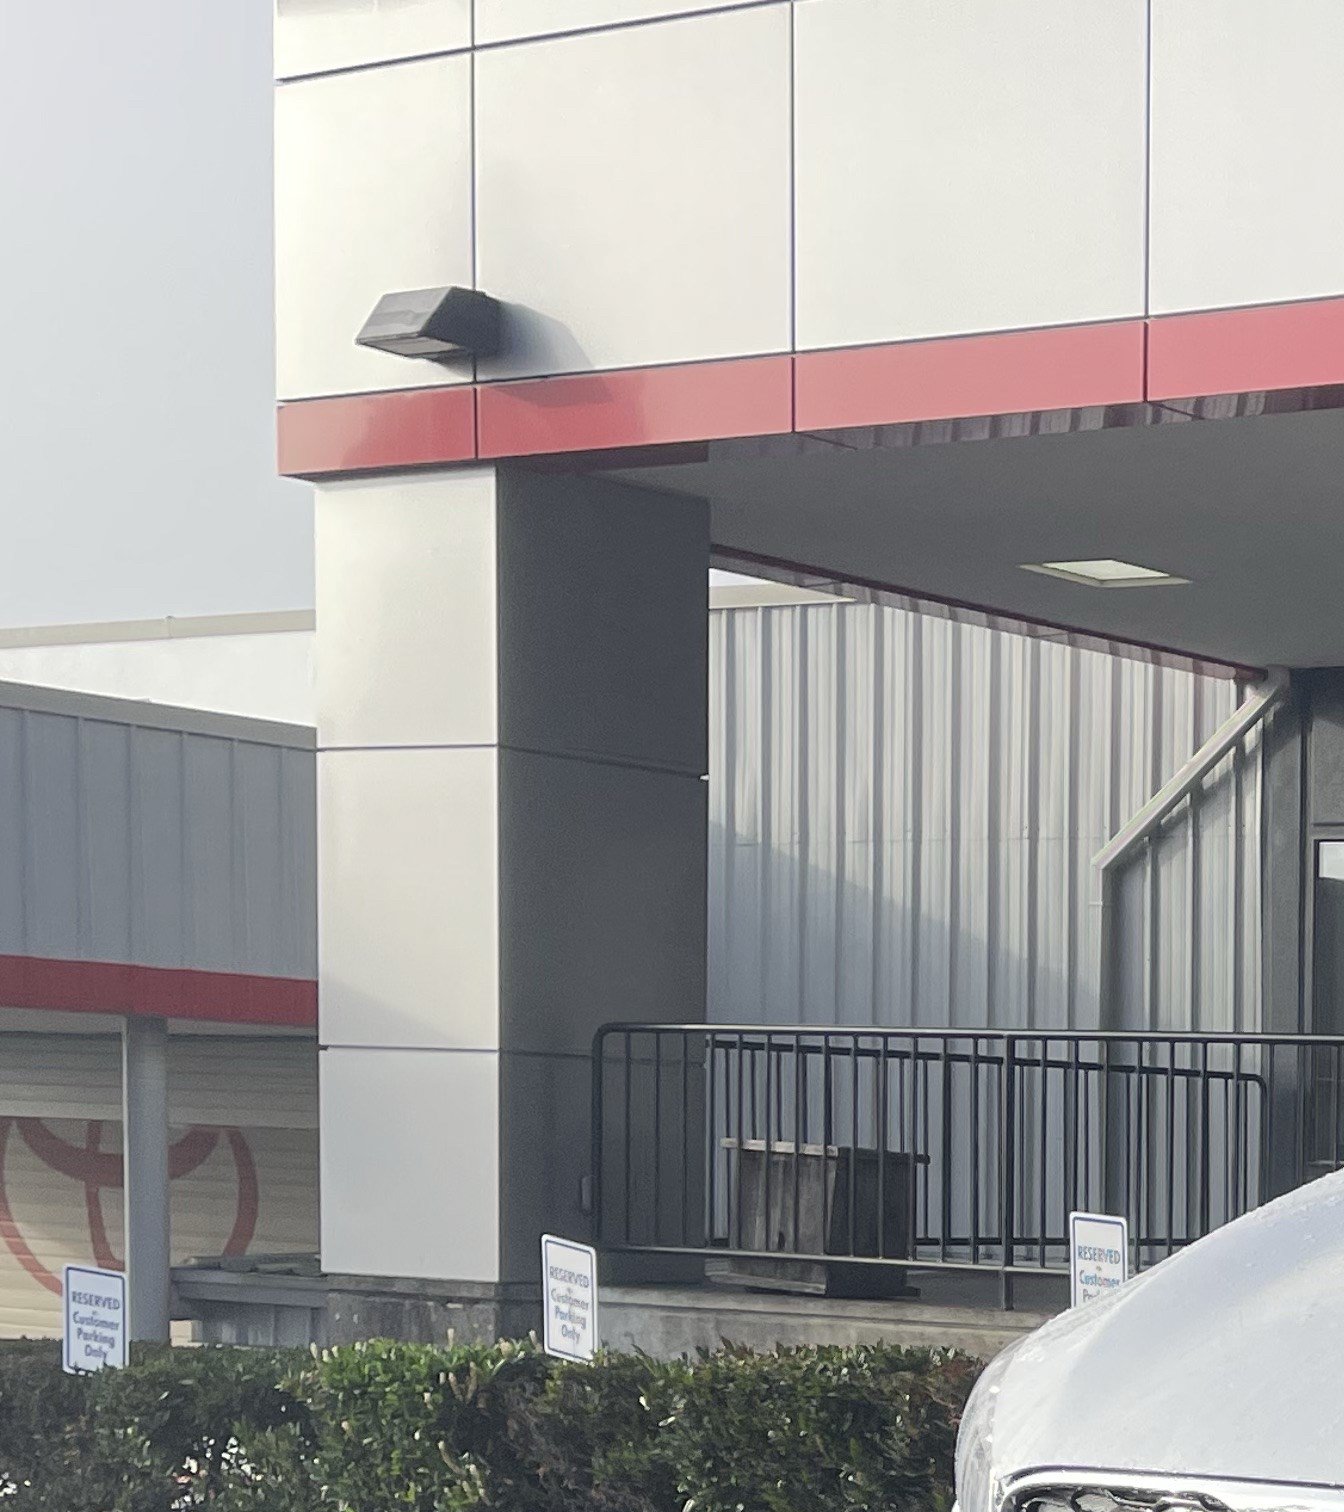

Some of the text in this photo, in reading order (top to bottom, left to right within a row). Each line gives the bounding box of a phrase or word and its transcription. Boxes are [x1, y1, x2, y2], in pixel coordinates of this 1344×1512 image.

[1077, 1245, 1121, 1265] RESERVED
[549, 1266, 589, 1289] RESERVED
[1079, 1270, 1121, 1287] Customer
[71, 1291, 120, 1310] RESERVED
[551, 1288, 589, 1311] Customer
[72, 1311, 119, 1331] Customer
[554, 1305, 587, 1330] Parking
[76, 1327, 116, 1349] Parking
[561, 1324, 581, 1344] Only
[84, 1344, 107, 1362] Only
